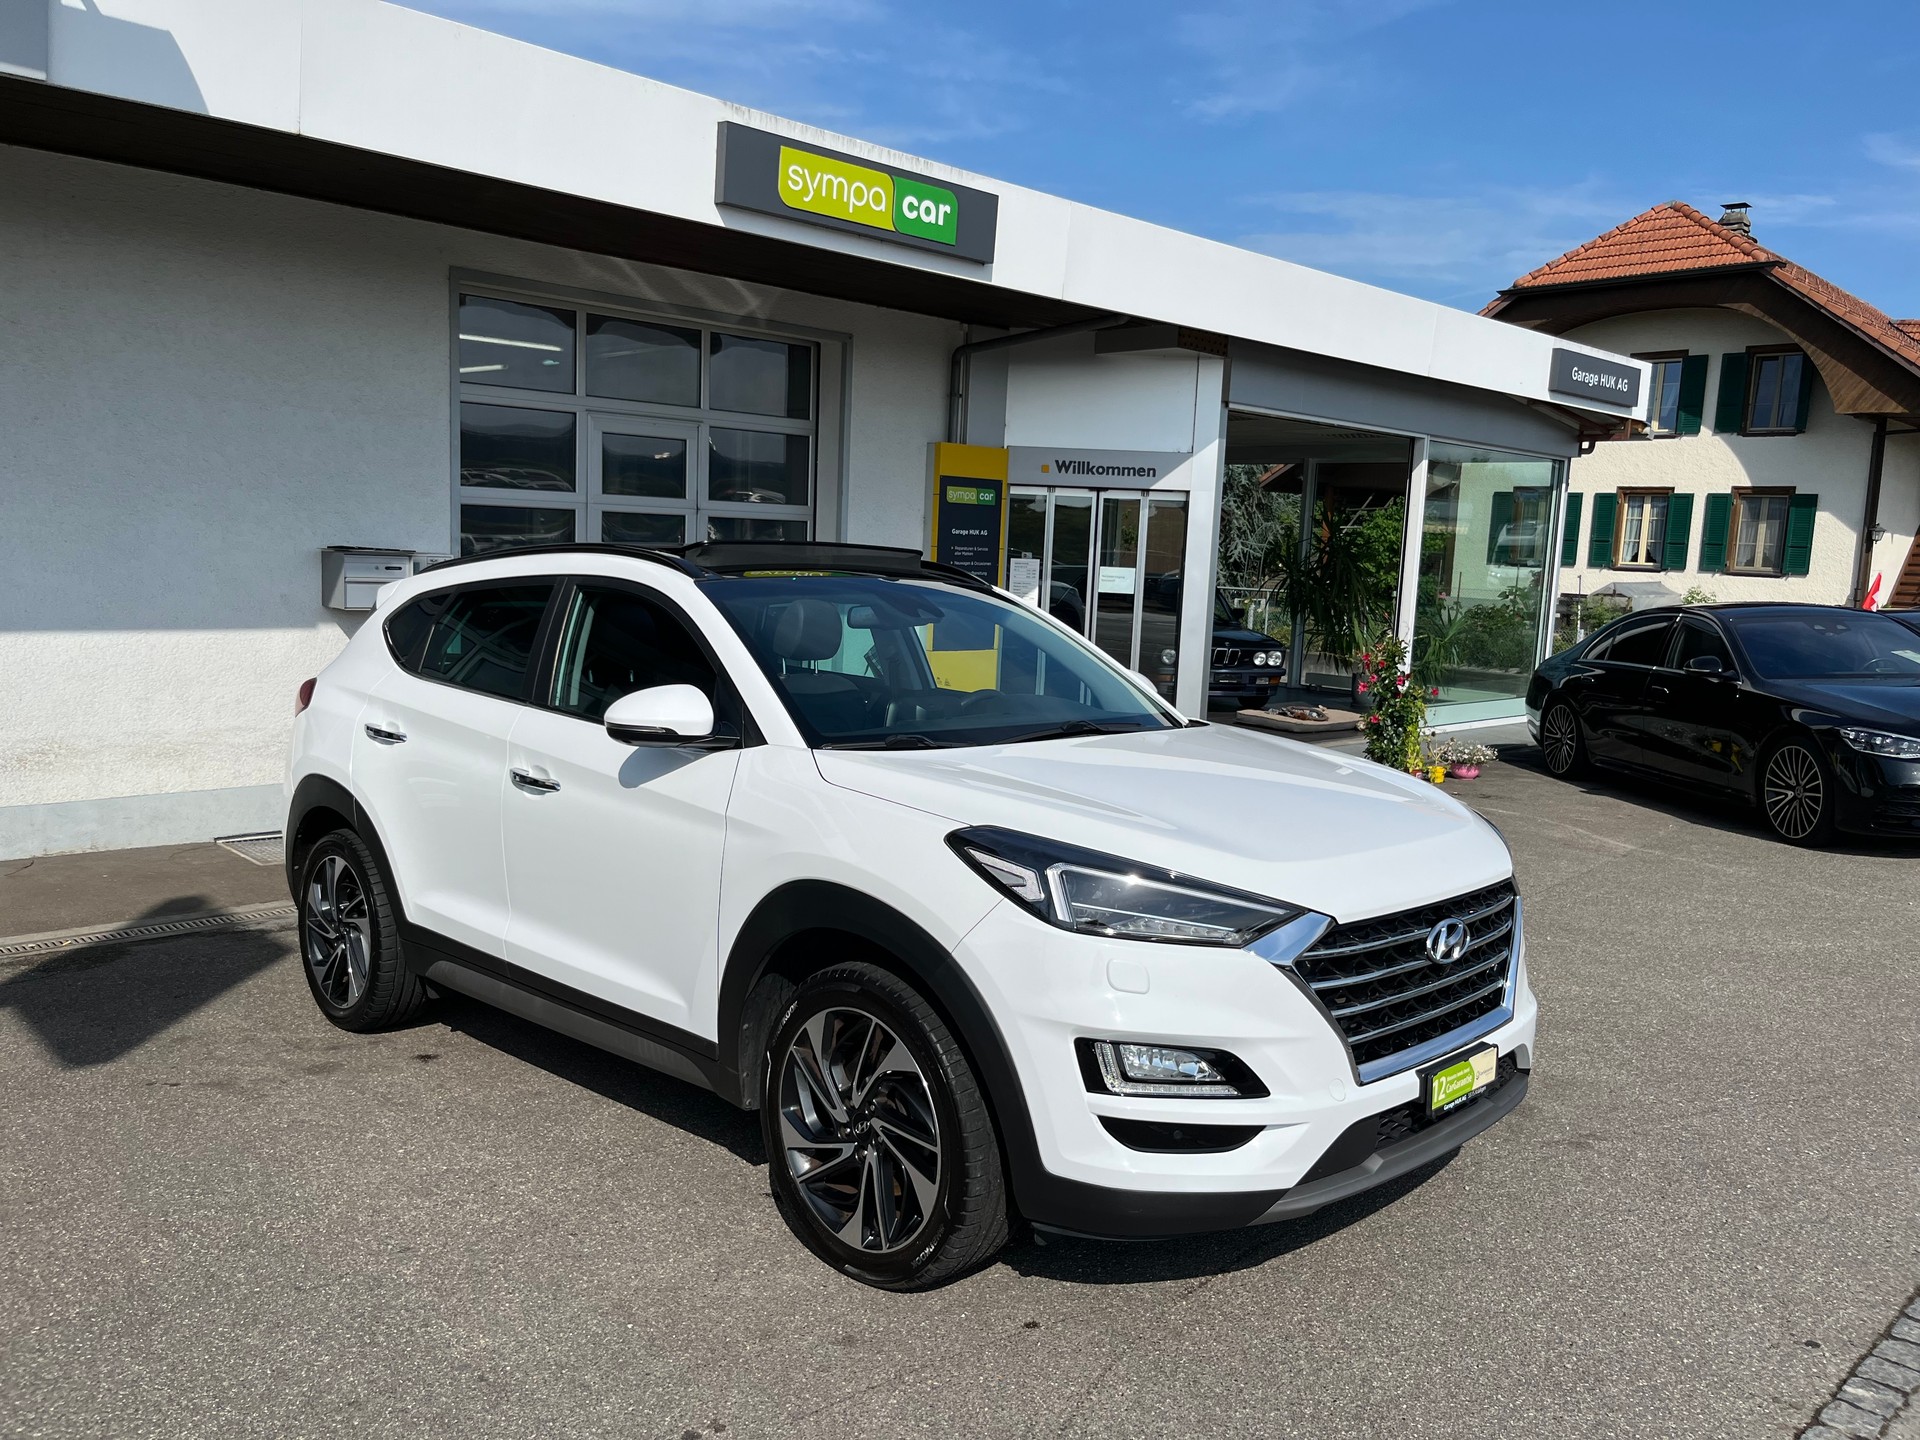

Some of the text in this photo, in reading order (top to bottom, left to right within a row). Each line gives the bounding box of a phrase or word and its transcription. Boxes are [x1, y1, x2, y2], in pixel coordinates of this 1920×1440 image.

[787, 164, 951, 226] sympa car
[1571, 366, 1629, 392] Garage HUK AG
[1054, 459, 1157, 478] Willkommen
[948, 490, 994, 501] sympa car
[951, 528, 969, 536] Garage
[1433, 1076, 1447, 1102] 12
